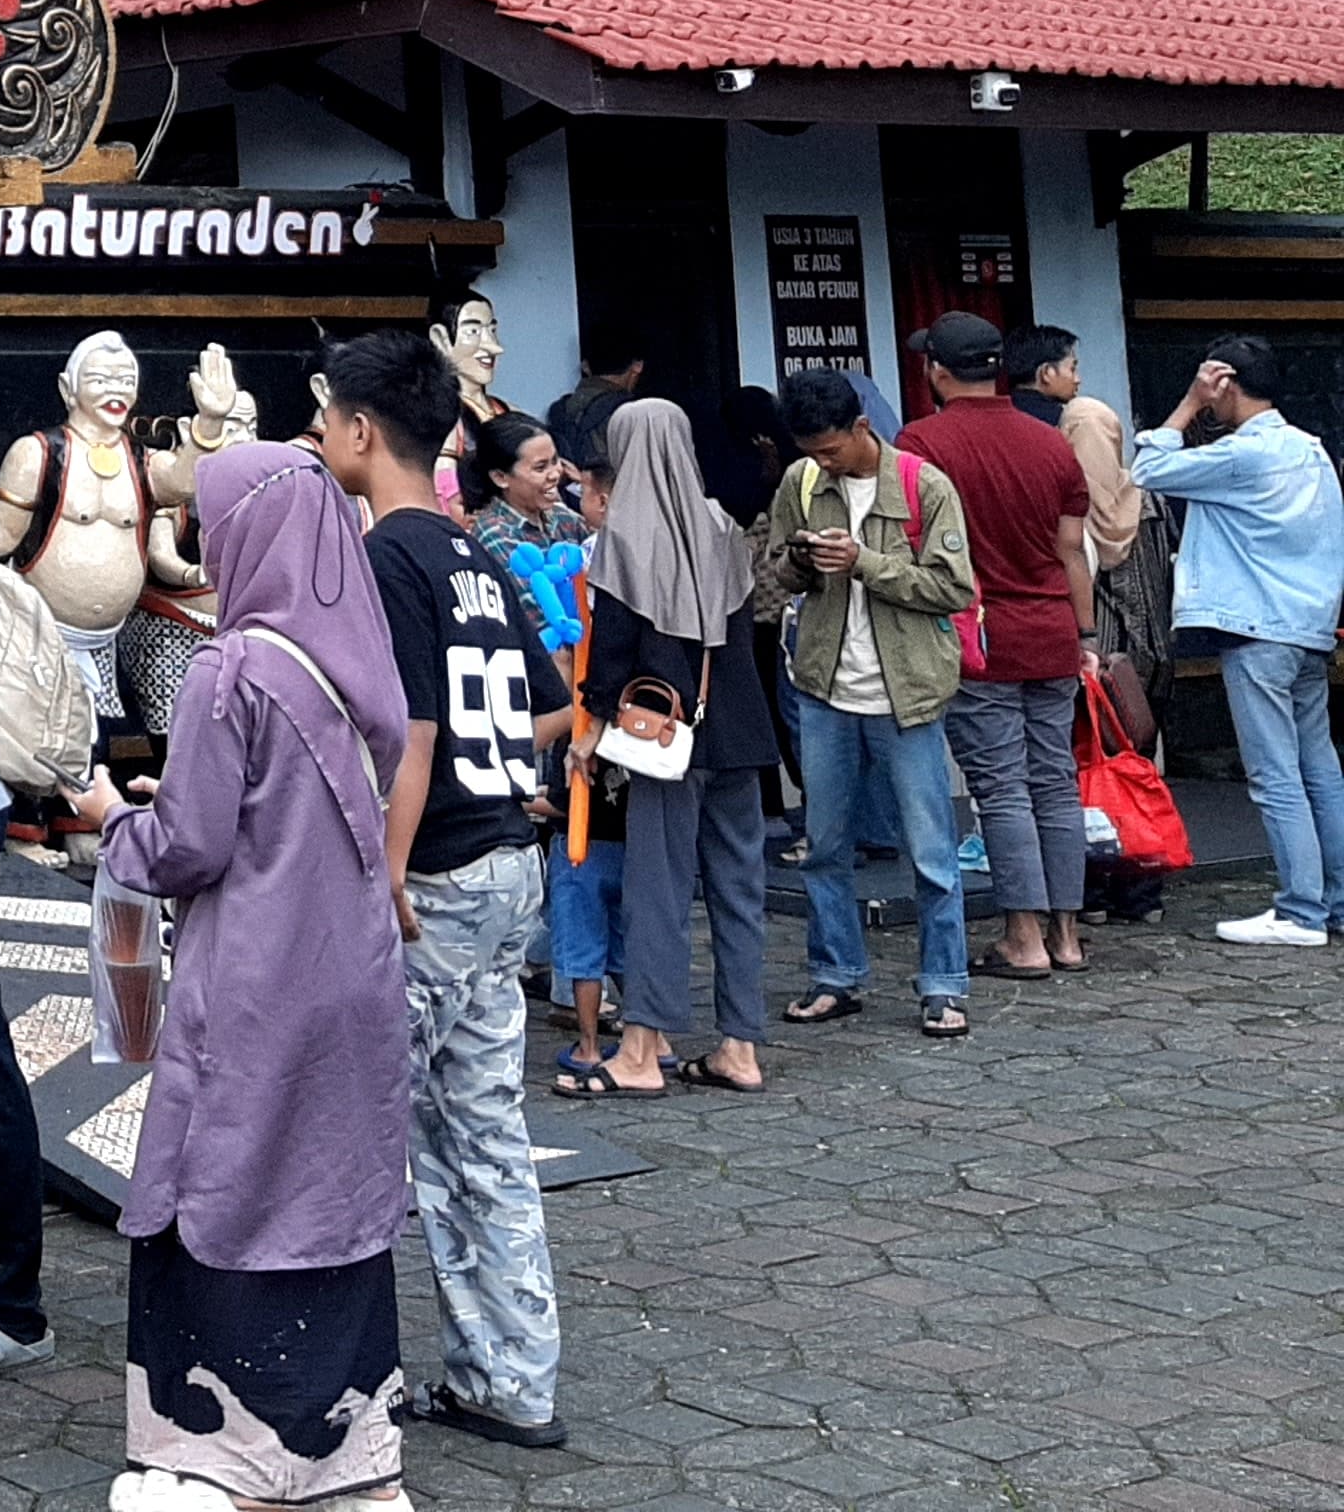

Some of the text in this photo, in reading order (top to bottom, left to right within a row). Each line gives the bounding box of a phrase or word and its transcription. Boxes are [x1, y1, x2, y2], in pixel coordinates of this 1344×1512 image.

[772, 227, 855, 246] USIA 3 TAHUN
[793, 253, 842, 273] KE ATAS
[776, 280, 860, 299] BAYAR PENUH
[785, 325, 858, 347] BUKA JAM
[446, 645, 537, 797] 99
